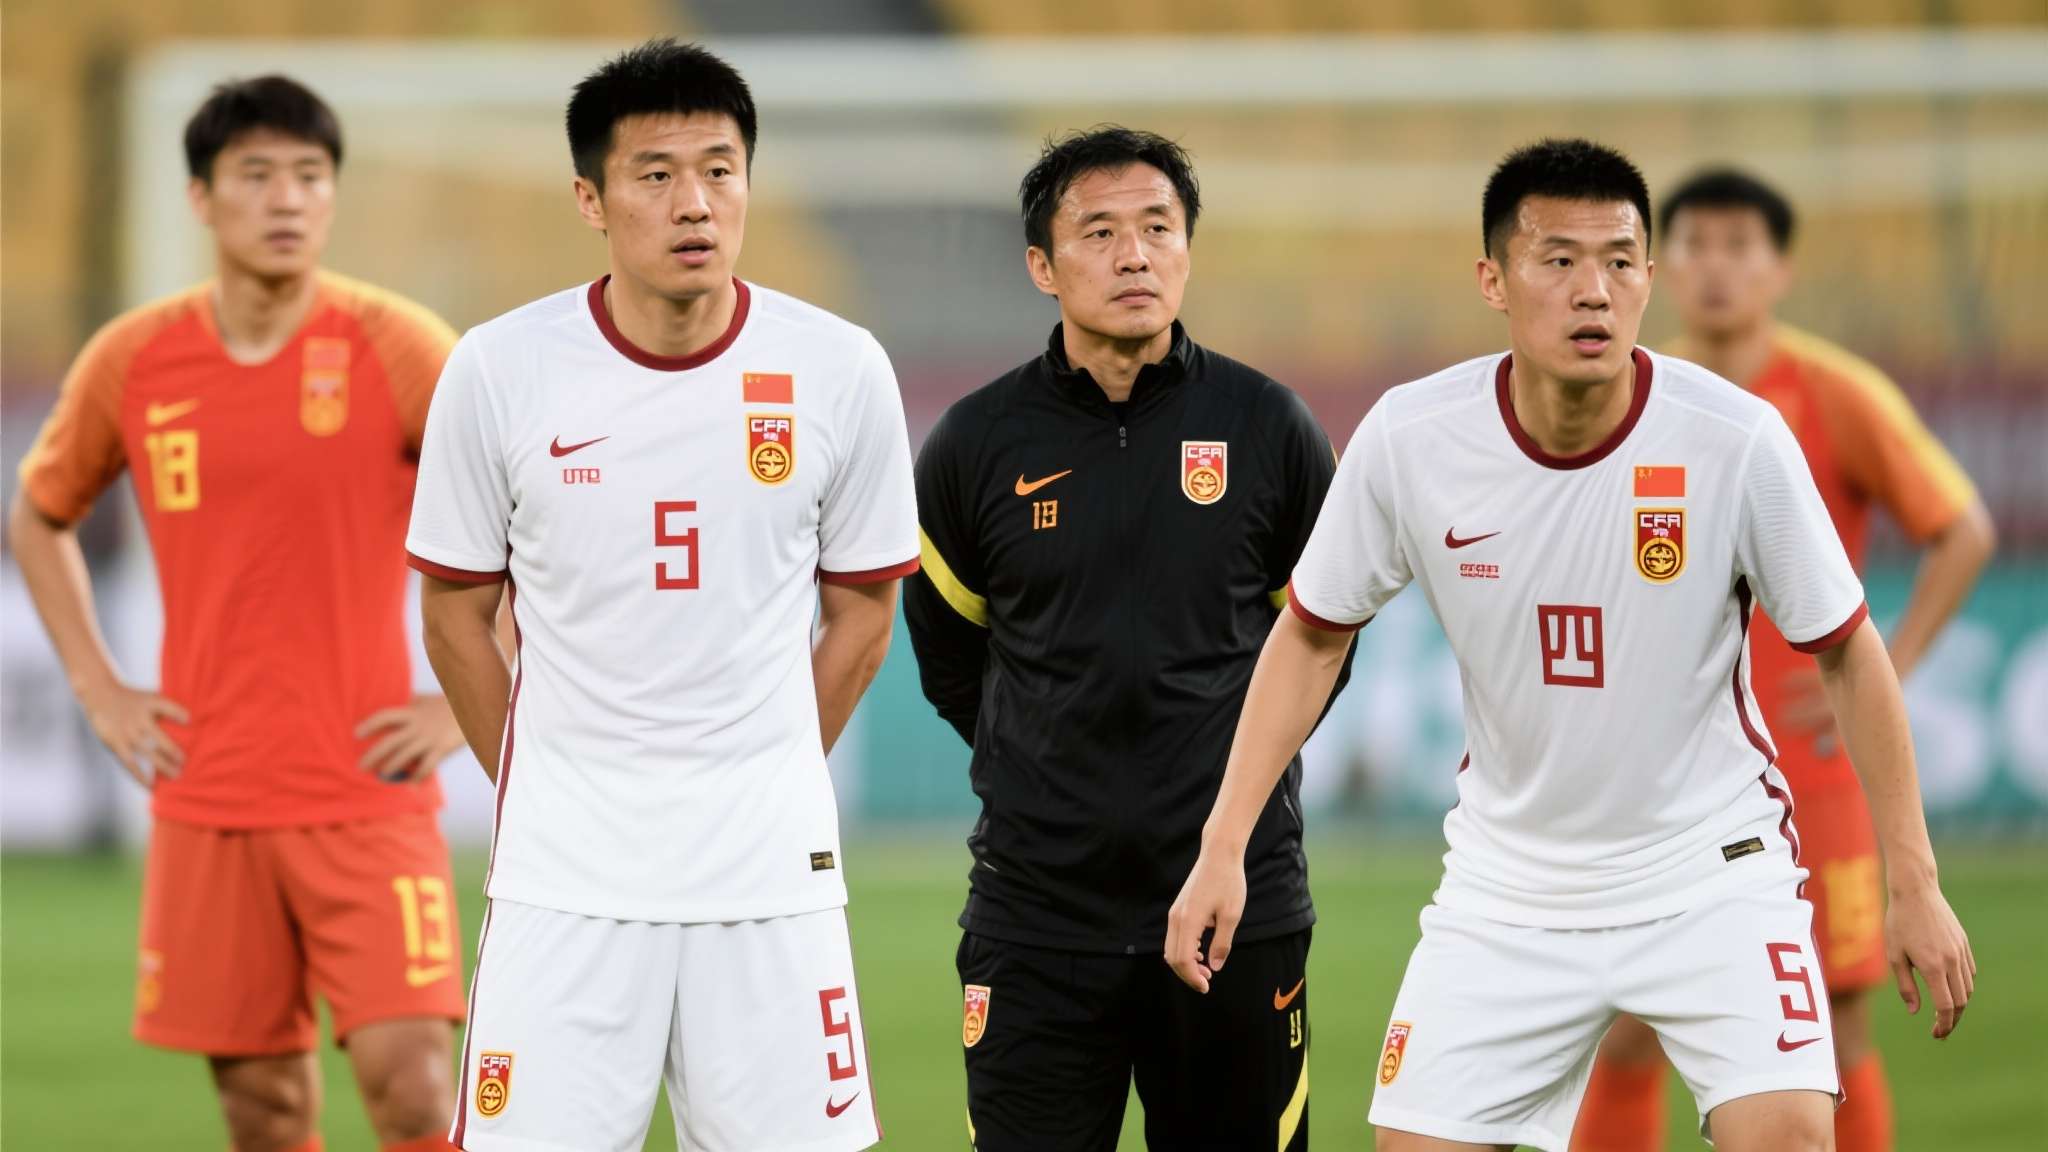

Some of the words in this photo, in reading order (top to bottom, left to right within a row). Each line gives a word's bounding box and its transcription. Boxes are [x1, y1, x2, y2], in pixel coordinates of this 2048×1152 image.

[751, 419, 790, 432] CFA
[1187, 447, 1222, 458] CFA
[144, 430, 201, 513] 18
[655, 500, 700, 590] 5
[1640, 514, 1680, 528] CFA
[392, 876, 453, 959] 13
[1766, 942, 1819, 1023] 5
[482, 1056, 510, 1069] CFA
[818, 986, 858, 1082] 5
